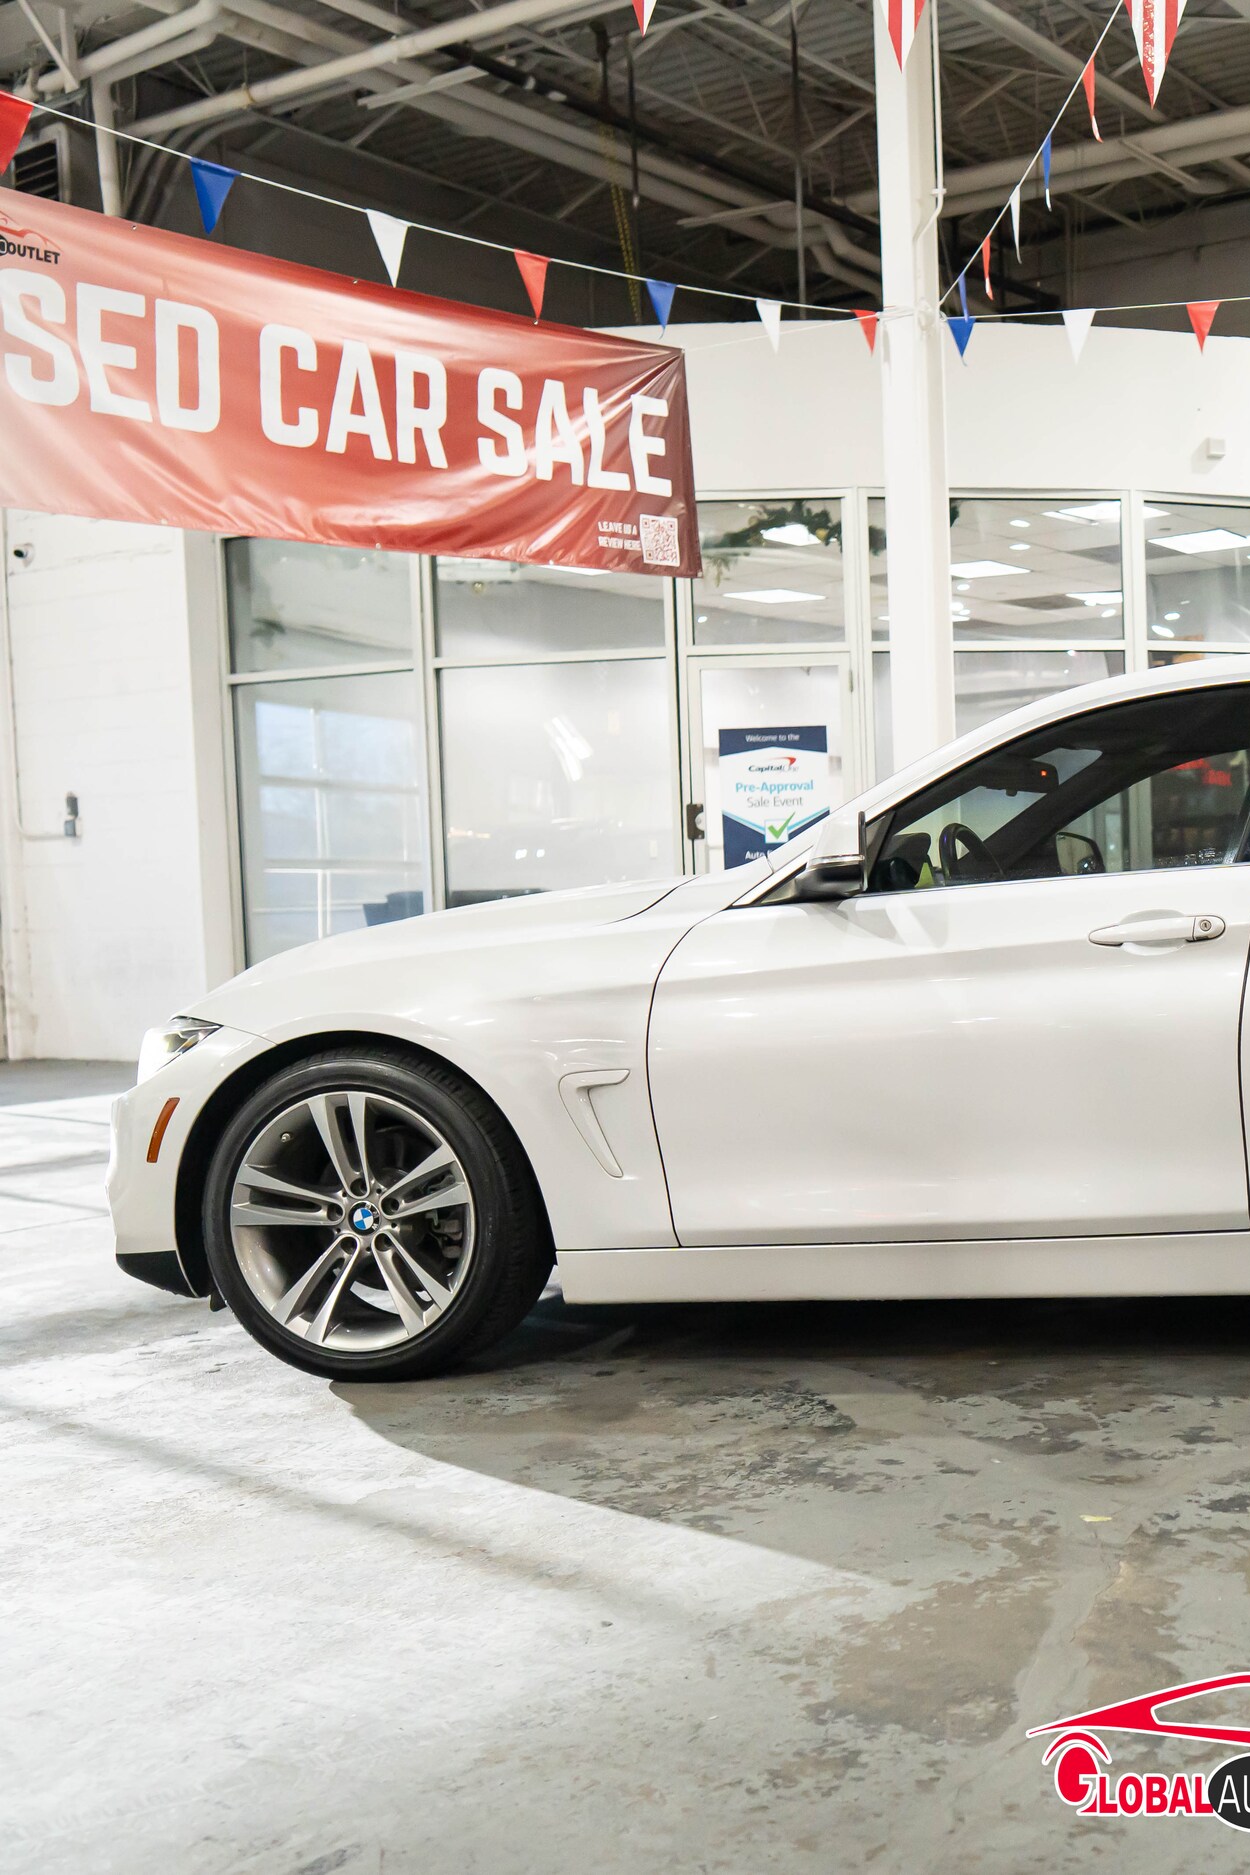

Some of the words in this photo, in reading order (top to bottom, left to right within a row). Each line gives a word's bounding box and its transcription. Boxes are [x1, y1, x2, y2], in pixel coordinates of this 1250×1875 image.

[7, 241, 60, 265] OUTLET
[259, 323, 448, 469] CAR
[477, 367, 673, 498] SALE
[598, 521, 623, 534] LEAVE
[745, 734, 777, 743] Welcome
[788, 733, 800, 741] the
[735, 780, 814, 794] Pre-Approval
[747, 796, 770, 808] Sale
[773, 796, 804, 807] Event
